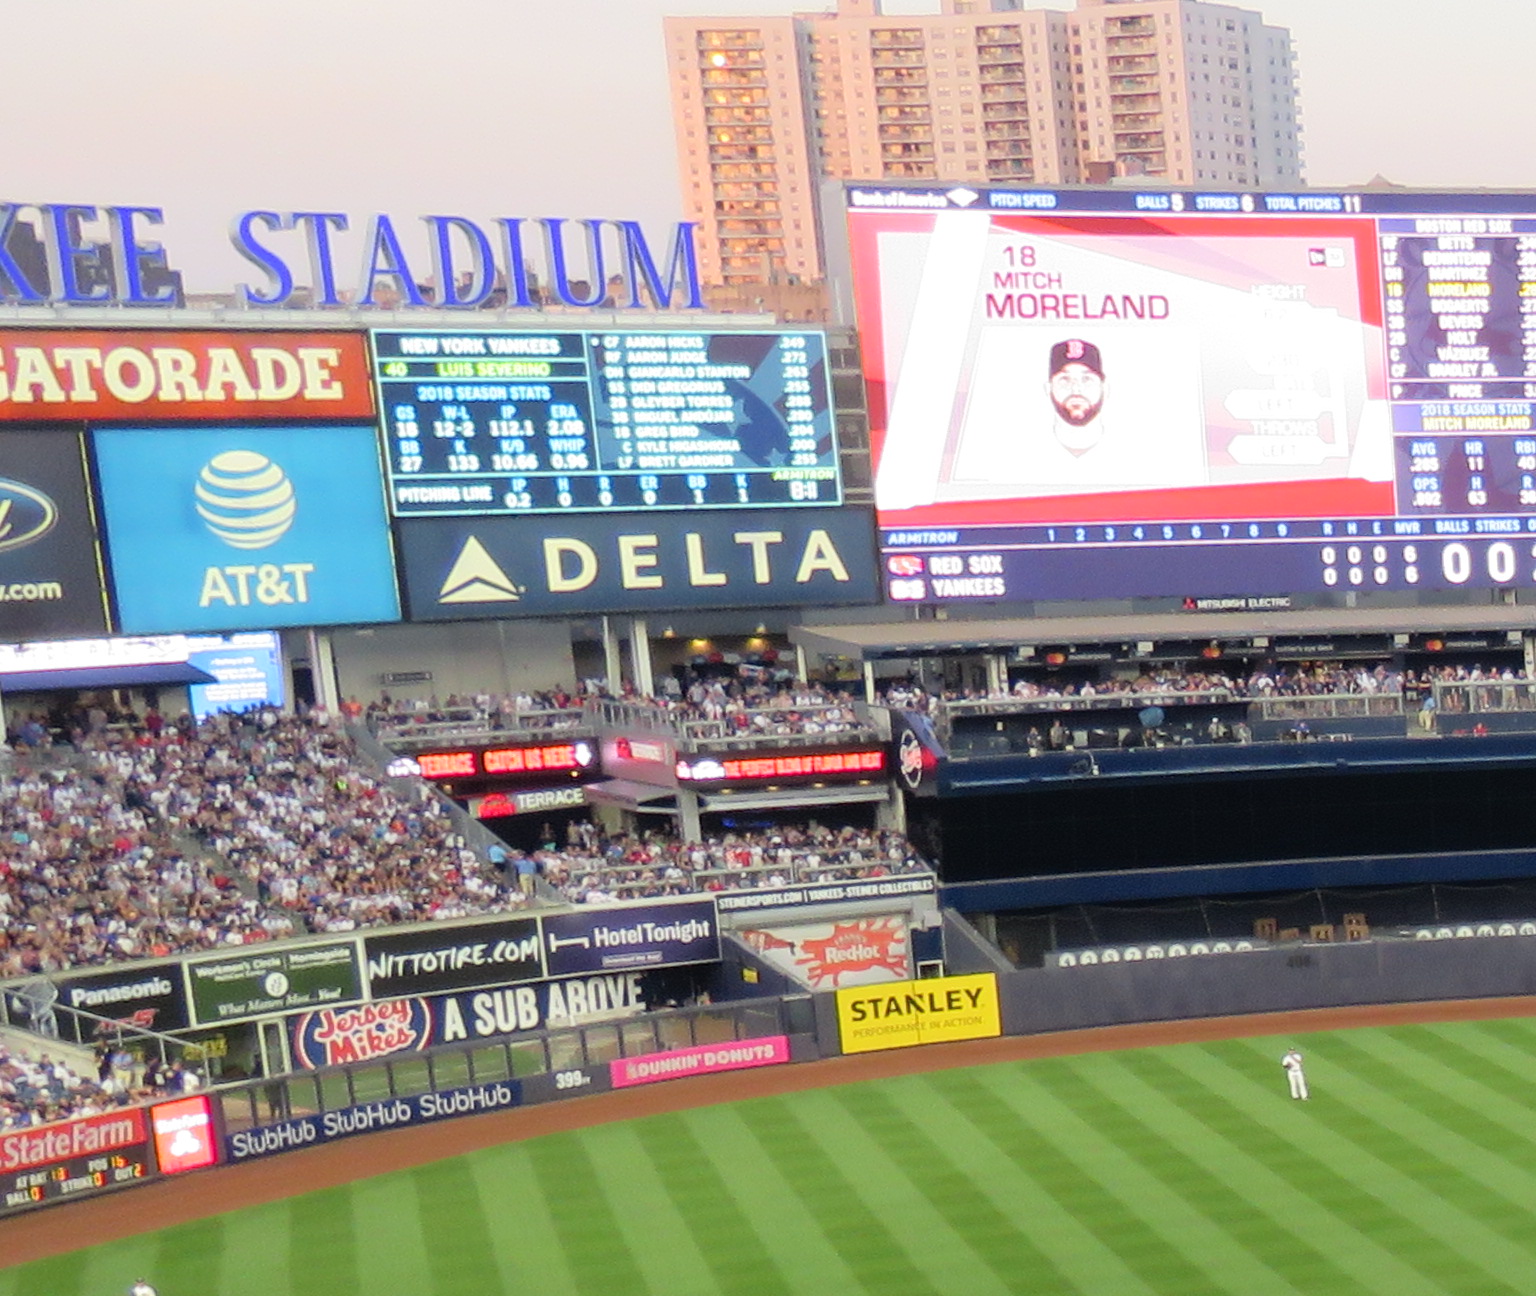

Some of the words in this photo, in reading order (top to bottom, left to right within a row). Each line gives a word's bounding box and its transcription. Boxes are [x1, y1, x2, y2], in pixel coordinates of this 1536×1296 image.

[989, 192, 1021, 207] PITCH
[1023, 193, 1056, 208] SPEED
[1135, 194, 1169, 210] BALLS
[1195, 195, 1239, 210] STRIKES
[1264, 195, 1297, 210] TOTAL
[1298, 196, 1341, 211] PITCHES
[1343, 195, 1361, 213] 11
[230, 208, 706, 311] STADIUM
[1002, 245, 1036, 267] 18
[993, 271, 1062, 289] MITCH
[985, 293, 1169, 319] MORELAND
[400, 336, 438, 354] NEW
[441, 337, 486, 354] YORK
[487, 337, 561, 355] YANKEES
[0, 347, 344, 403] ATORADE
[384, 362, 409, 377] 40
[436, 362, 474, 377] LUIS
[475, 362, 551, 377] SEVERINO
[417, 385, 453, 401] 2018
[454, 385, 507, 401] SEASON
[509, 385, 552, 401] STATS
[1421, 404, 1450, 416] 2018
[1453, 404, 1495, 416] SEASON
[1498, 403, 1532, 415] STATS
[1422, 417, 1463, 431] MITCH
[1465, 416, 1531, 431] MORELAND
[1464, 440, 1484, 456] HR
[1515, 440, 1536, 455] RBI
[1517, 456, 1536, 470] 40
[1435, 519, 1470, 533] BALLS
[1475, 519, 1521, 533] STRIKES
[887, 531, 959, 545] ARMITRON
[543, 529, 850, 593] DELTA
[928, 556, 963, 575] RED
[968, 555, 1004, 575] SOX
[1442, 542, 1471, 584] 0
[1487, 541, 1516, 583] 0
[198, 562, 314, 607] AT&T
[931, 578, 1006, 598] YANKEES
[1248, 598, 1291, 608] ELECTRIC
[517, 788, 584, 809] TERRACE
[880, 879, 934, 894] COLLECTIBLES
[594, 919, 711, 949] HotelTonight
[368, 935, 538, 981] NITTOTIRE.COM
[825, 943, 881, 963] RedHot
[71, 976, 172, 1007] Panasonic
[443, 999, 468, 1042] A
[475, 986, 539, 1036] SUB
[545, 972, 647, 1026] ABOVE
[850, 987, 984, 1023] STANLEY
[314, 997, 413, 1040] Jersey
[328, 1024, 416, 1067] Mike's
[637, 1055, 702, 1079] DUNKIN'
[705, 1045, 775, 1069] DONUTS
[232, 1119, 316, 1158] StubHub
[323, 1099, 411, 1138] StubHub
[419, 1083, 512, 1118] StubHub
